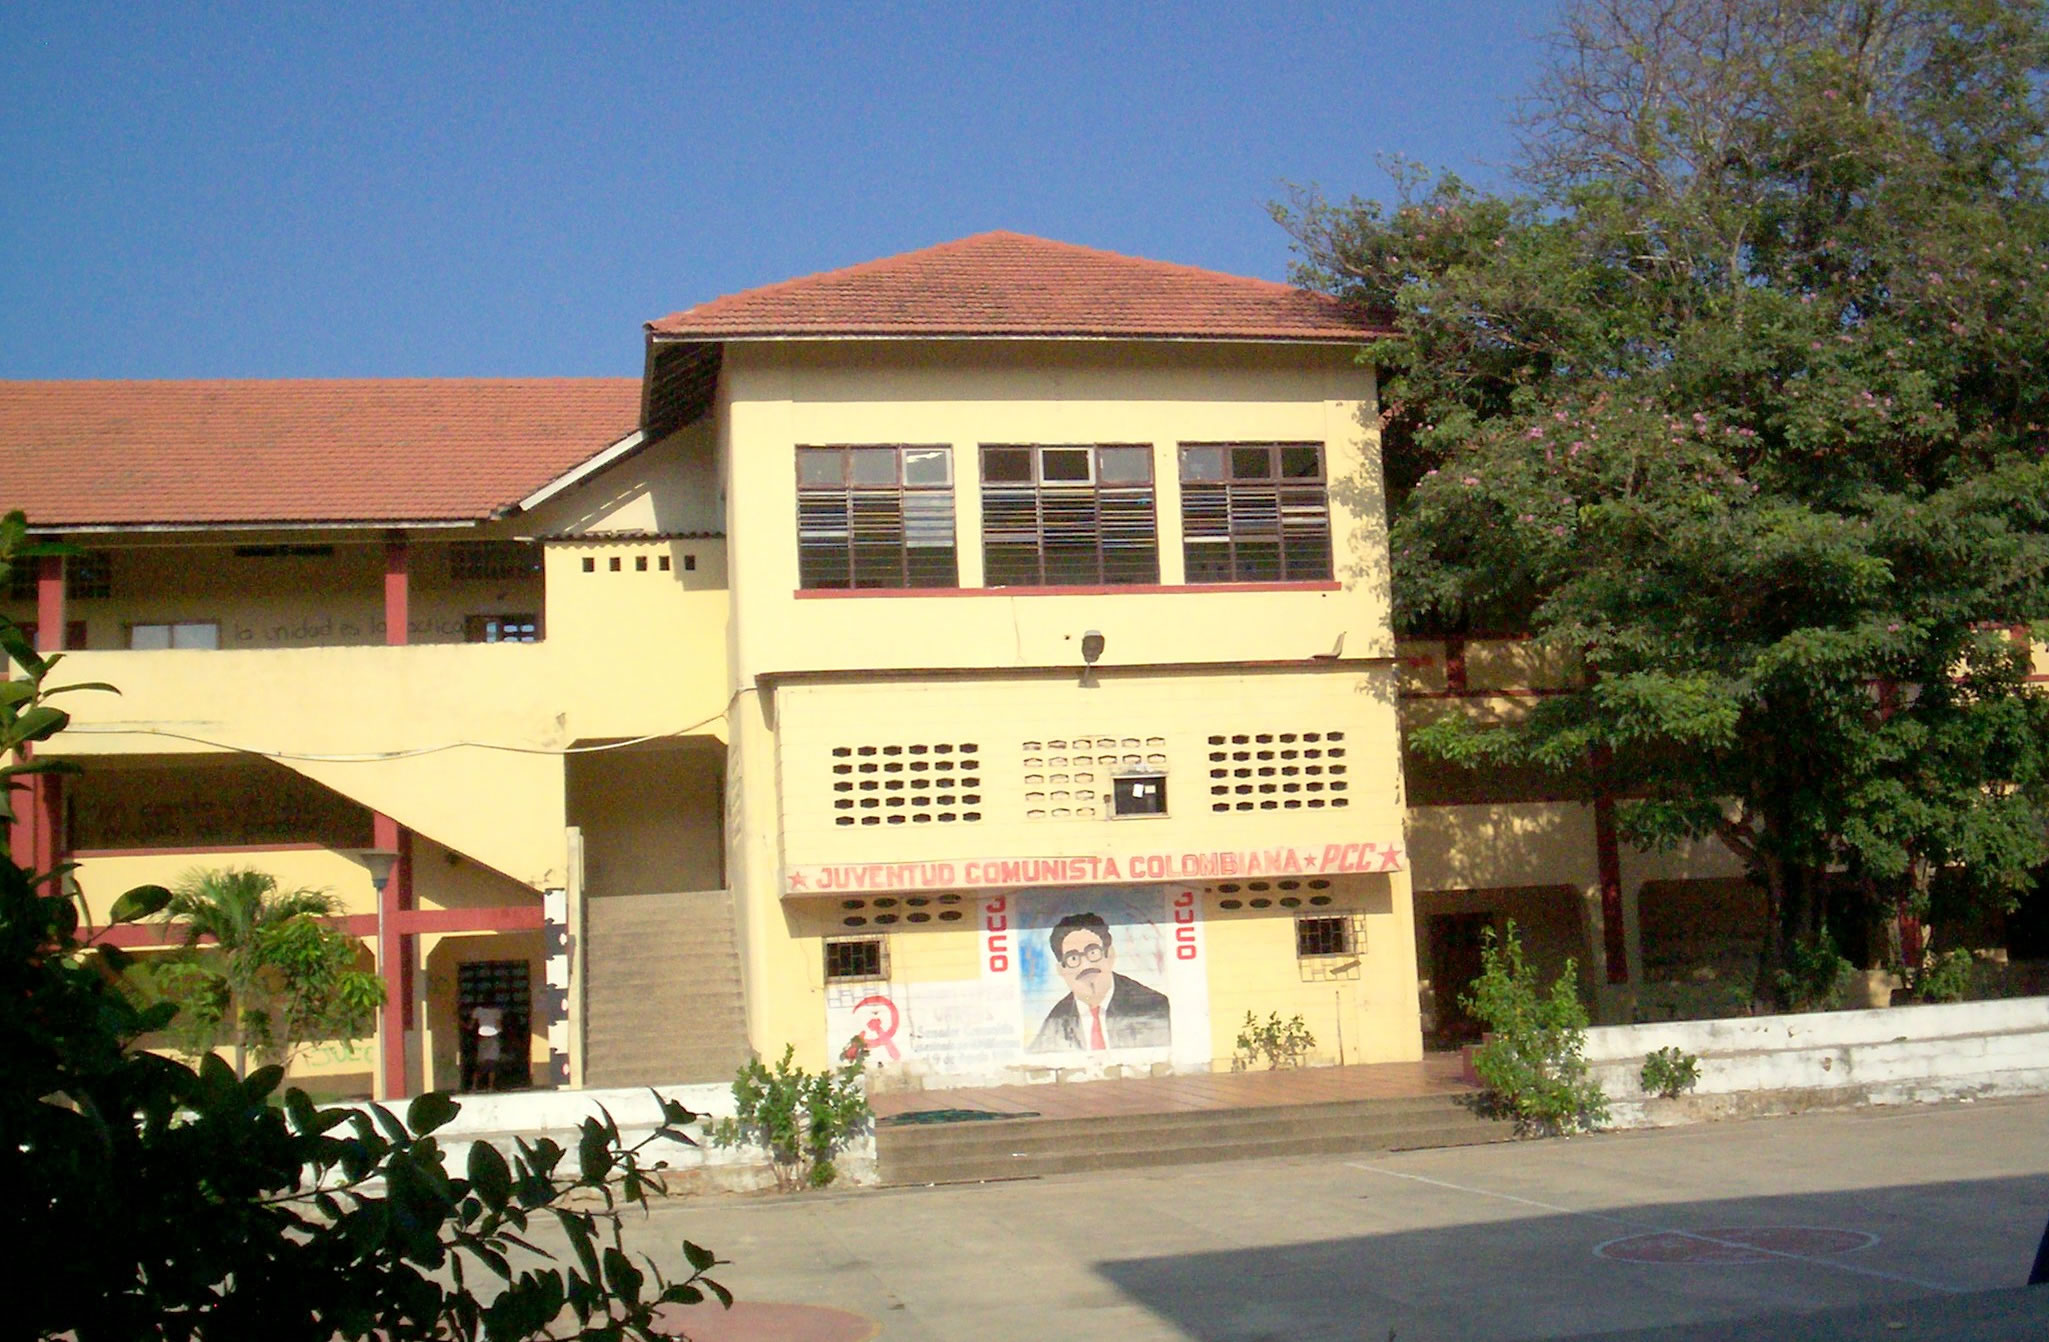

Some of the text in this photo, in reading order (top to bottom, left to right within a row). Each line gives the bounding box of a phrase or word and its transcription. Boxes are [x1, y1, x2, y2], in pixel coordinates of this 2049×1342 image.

[816, 842, 1377, 889] JUVENTUD COMUNISTA COLOMBIANA PCC
[985, 894, 1009, 973] JUCO
[1174, 891, 1198, 961] JUCO
